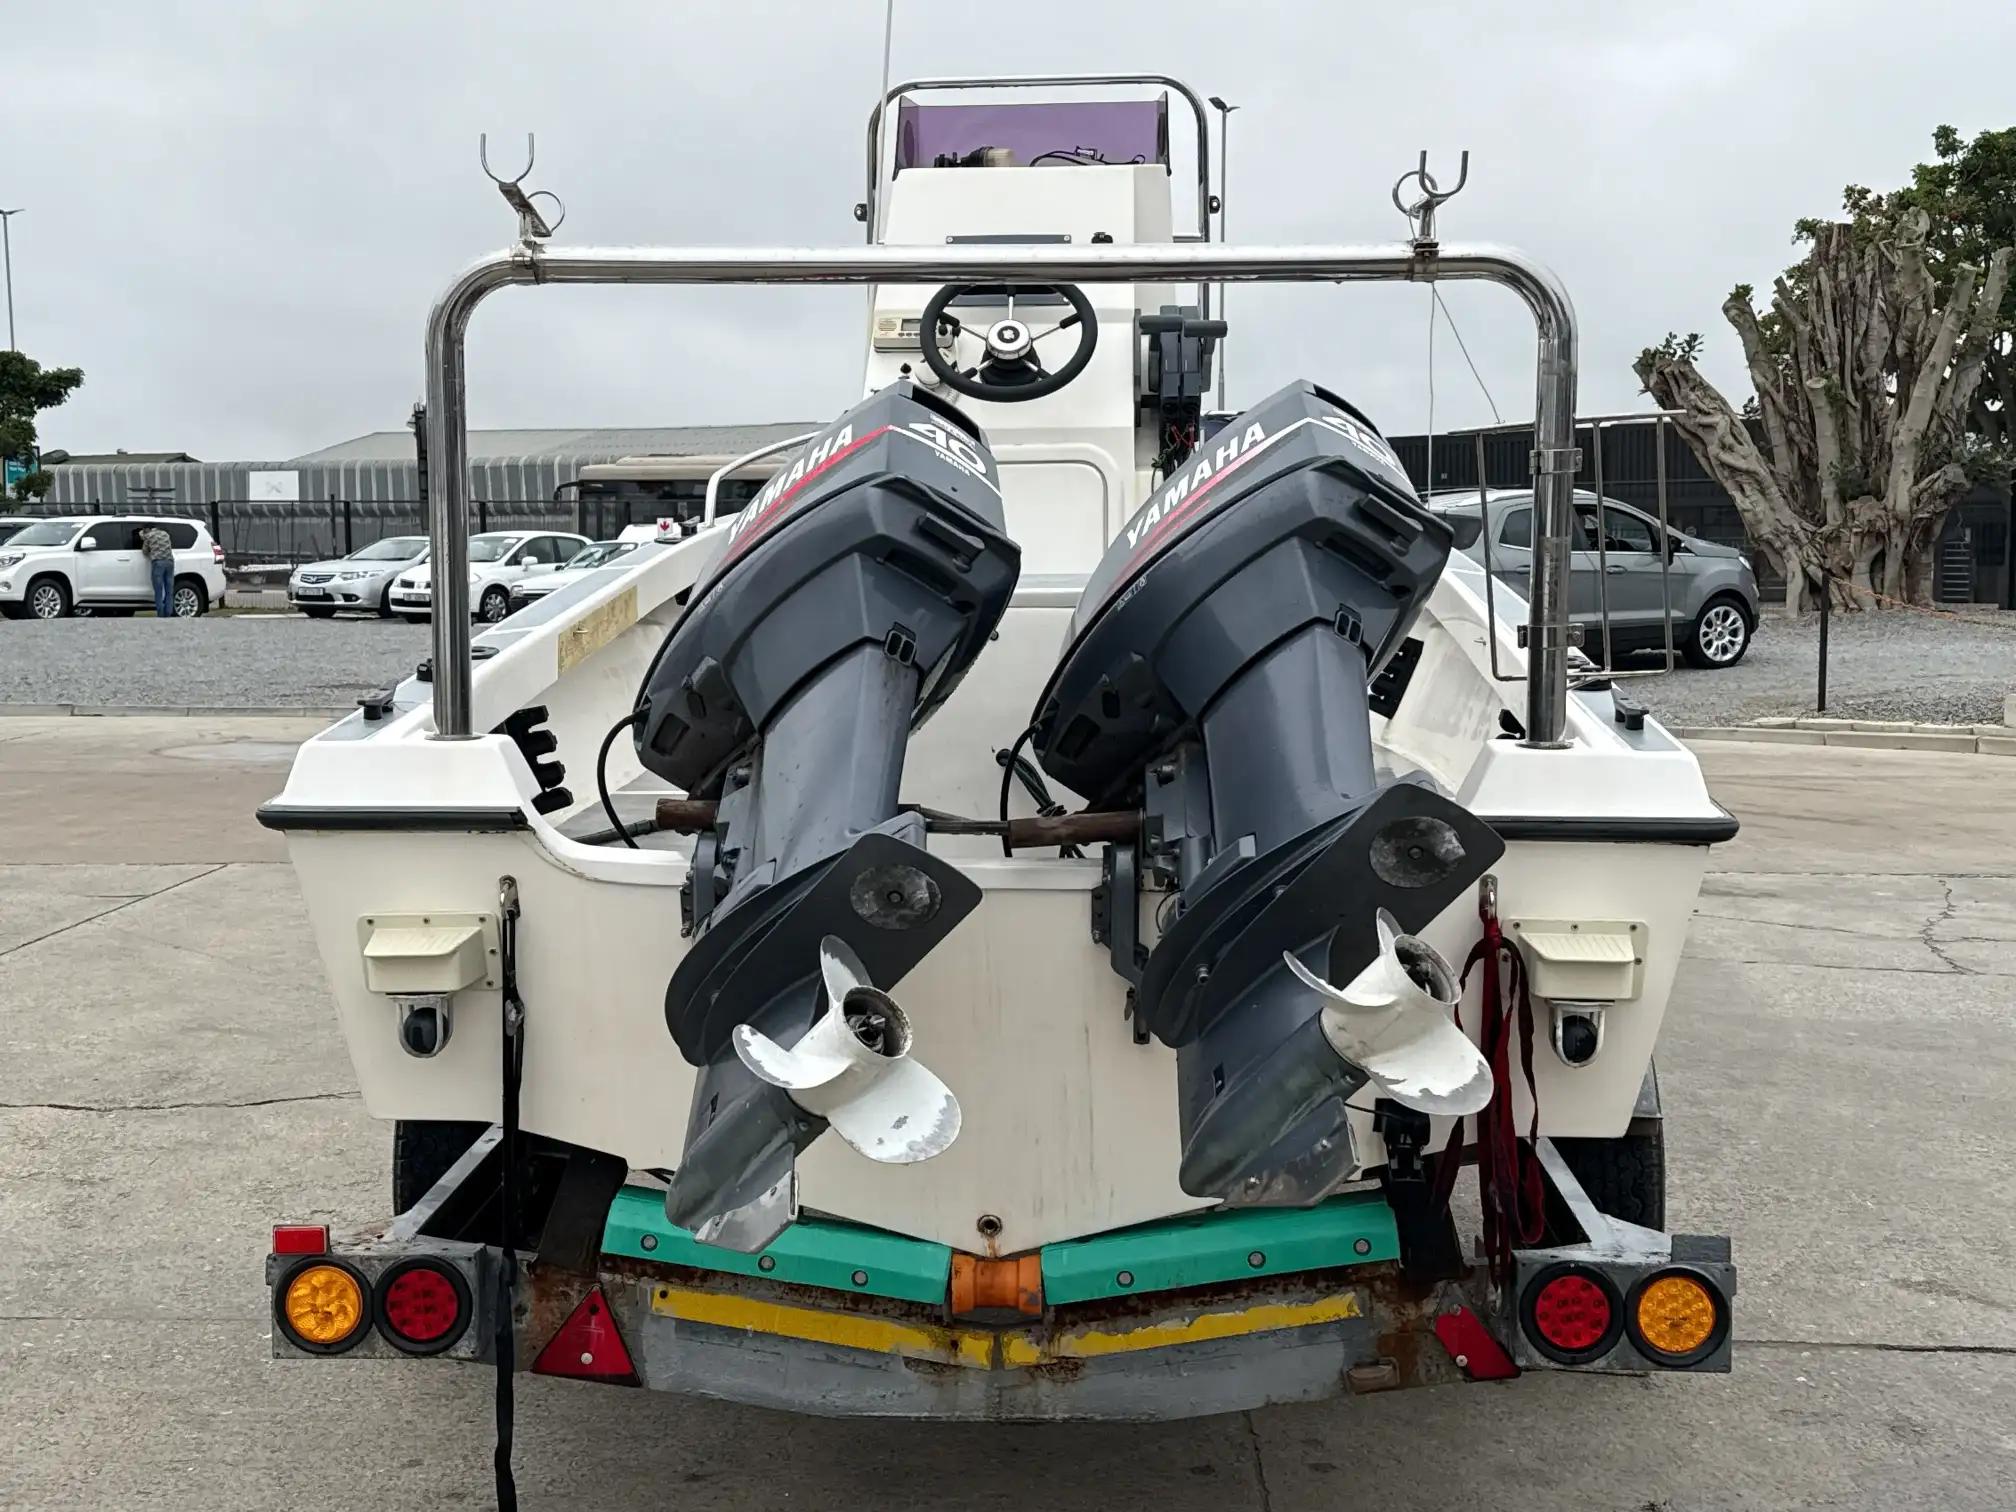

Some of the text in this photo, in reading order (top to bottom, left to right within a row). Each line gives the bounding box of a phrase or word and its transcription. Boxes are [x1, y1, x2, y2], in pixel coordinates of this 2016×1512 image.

[909, 423, 987, 474] 40
[935, 449, 970, 476] YAMAHA
[1322, 416, 1396, 466] 40
[728, 424, 852, 546] YAMAHA
[1127, 422, 1266, 549] YAMAHA
